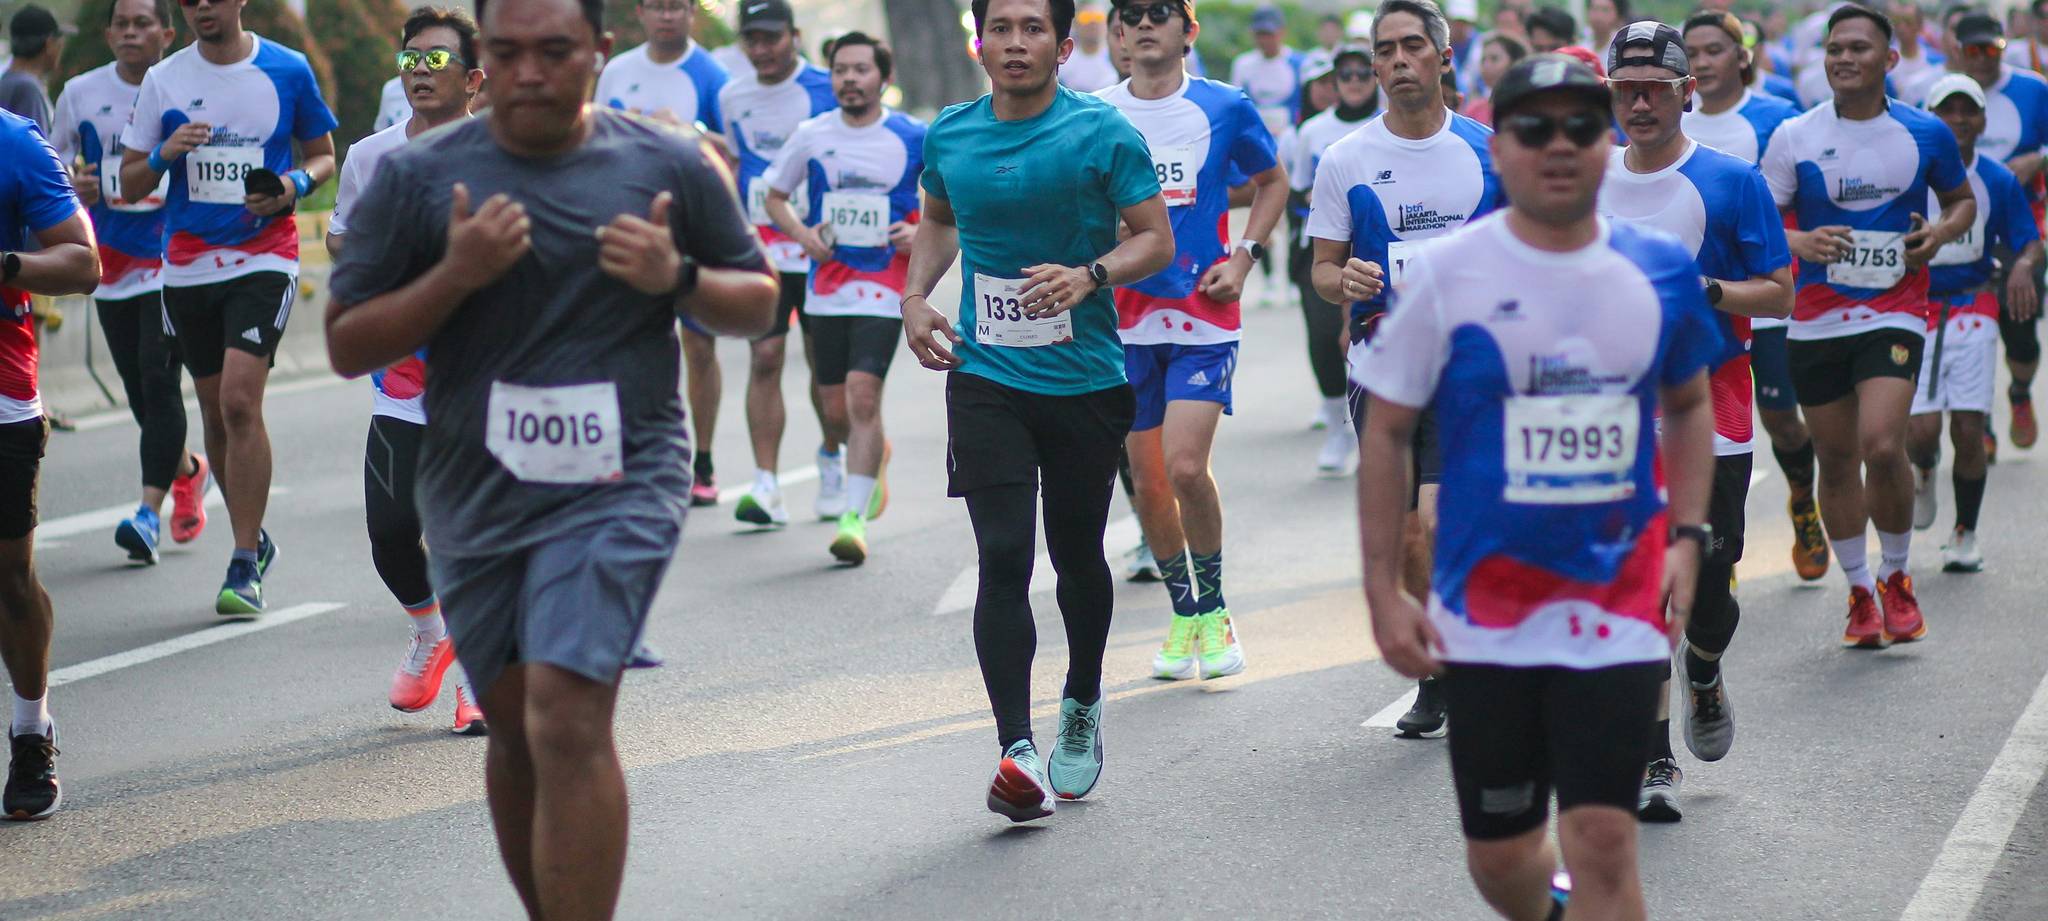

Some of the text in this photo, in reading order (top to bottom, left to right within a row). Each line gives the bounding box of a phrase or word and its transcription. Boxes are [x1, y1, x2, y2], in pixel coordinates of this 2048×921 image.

[196, 161, 253, 182] 11938
[831, 207, 878, 227] 16741
[1405, 210, 1437, 219] JAKARTA
[1405, 214, 1464, 225] INTERNATIONAL
[1406, 223, 1446, 231] MARATHON
[1836, 247, 1898, 267] 4753
[978, 325, 990, 336] M
[507, 409, 603, 446] 10016
[1521, 425, 1623, 461] 17993
